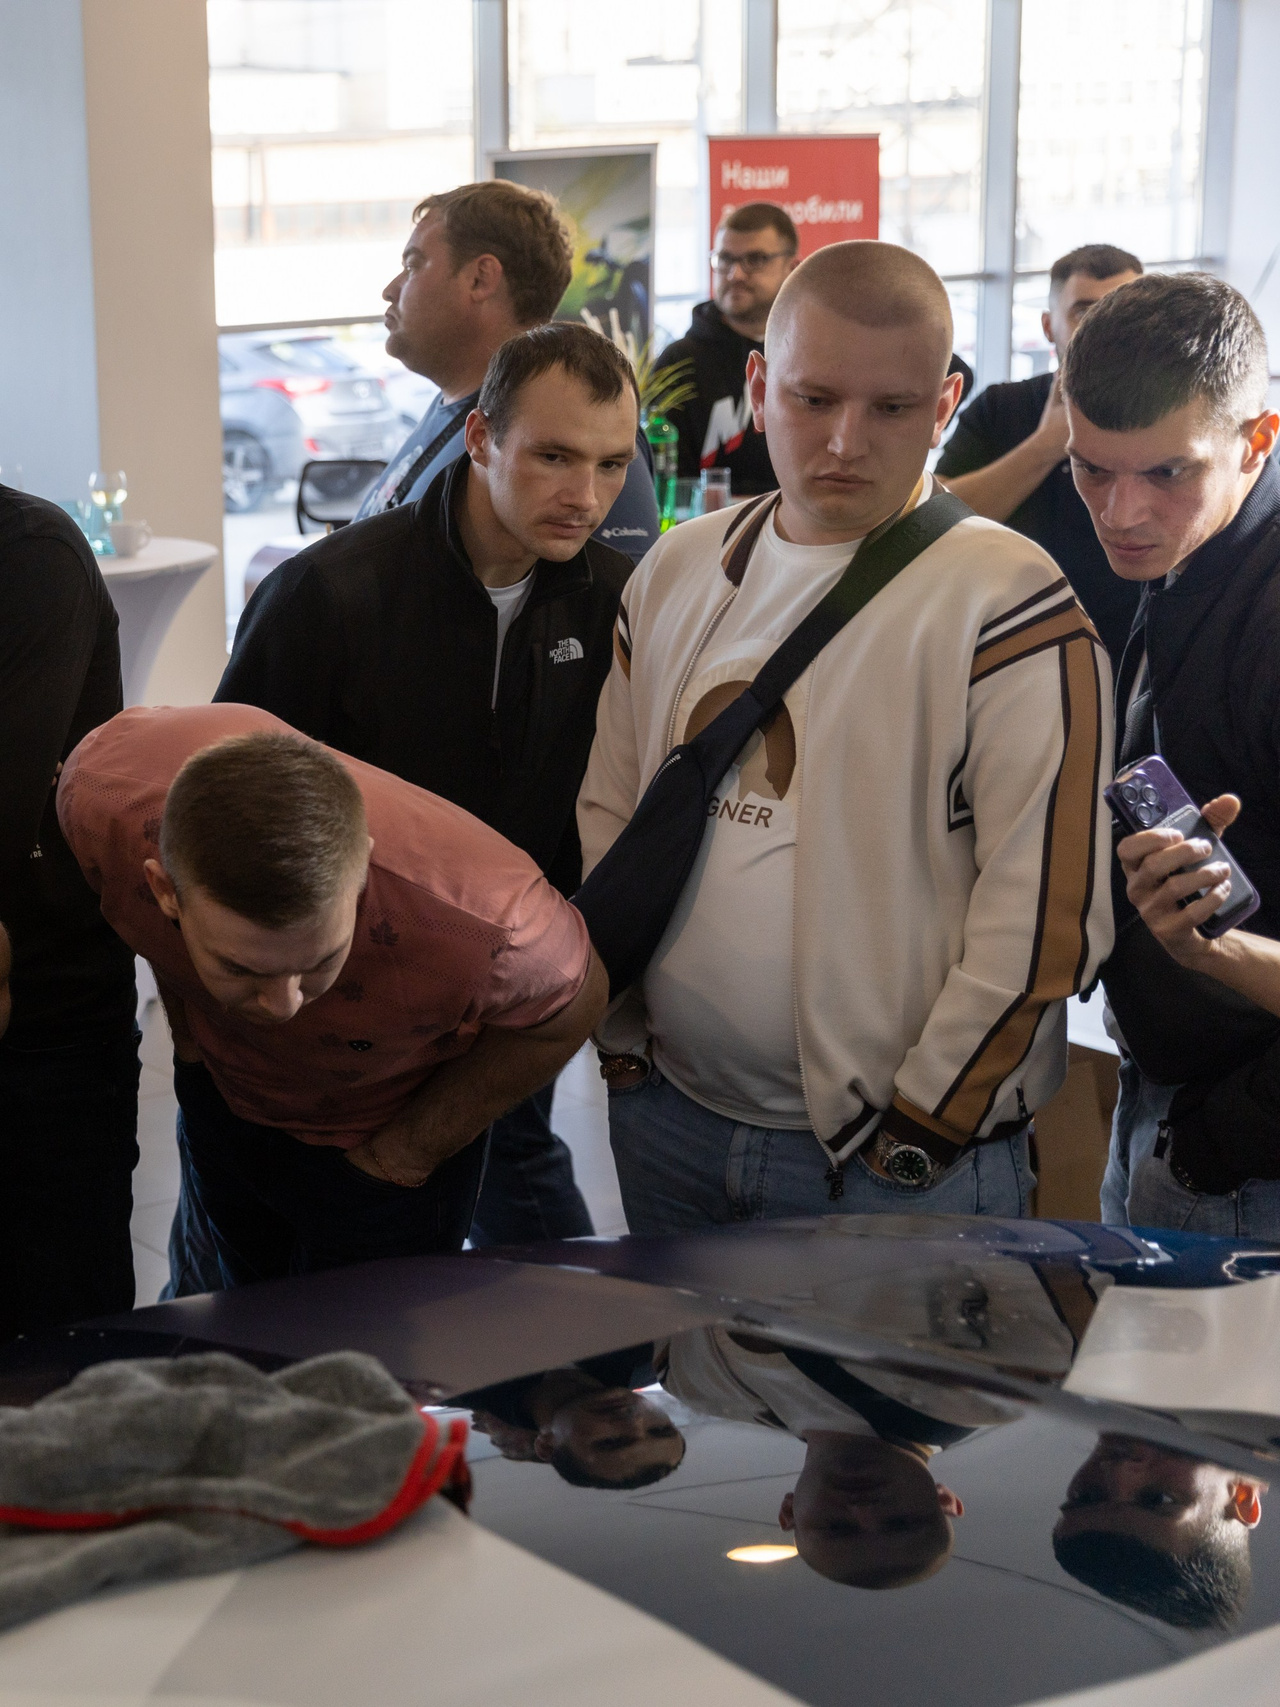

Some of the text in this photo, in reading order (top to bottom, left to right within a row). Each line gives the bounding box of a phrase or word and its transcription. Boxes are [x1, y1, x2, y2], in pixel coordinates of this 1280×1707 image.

[721, 160, 789, 189] Наши
[557, 638, 569, 648] THE
[549, 647, 570, 658] NORTH
[553, 654, 570, 664] FACE
